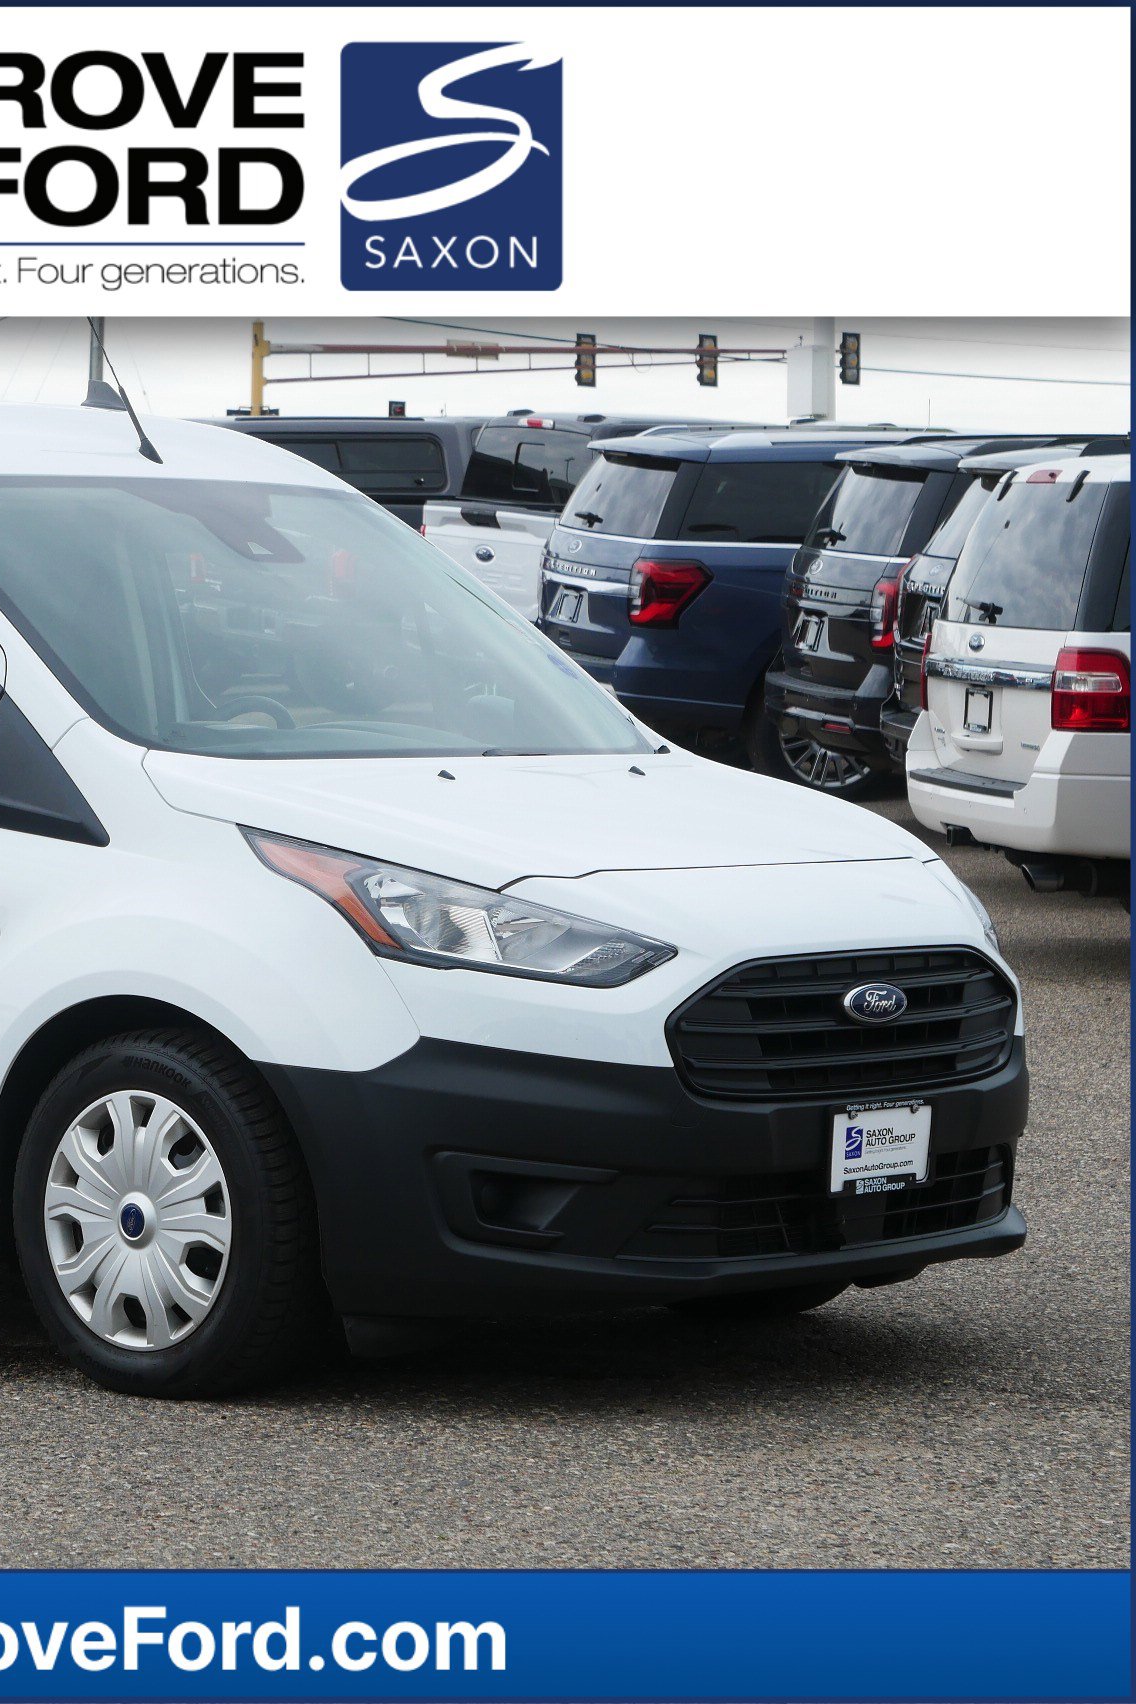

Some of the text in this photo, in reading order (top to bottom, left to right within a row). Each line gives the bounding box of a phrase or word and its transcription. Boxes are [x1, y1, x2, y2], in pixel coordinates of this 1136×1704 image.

[864, 990, 897, 1013] Ford
[866, 1127, 894, 1139] SAXON
[865, 1133, 916, 1147] AUTO GROUP
[843, 1160, 914, 1175] SaxonAutoGroup.com
[864, 1177, 887, 1186] SAXON
[864, 1182, 906, 1193] AUTO GROUP
